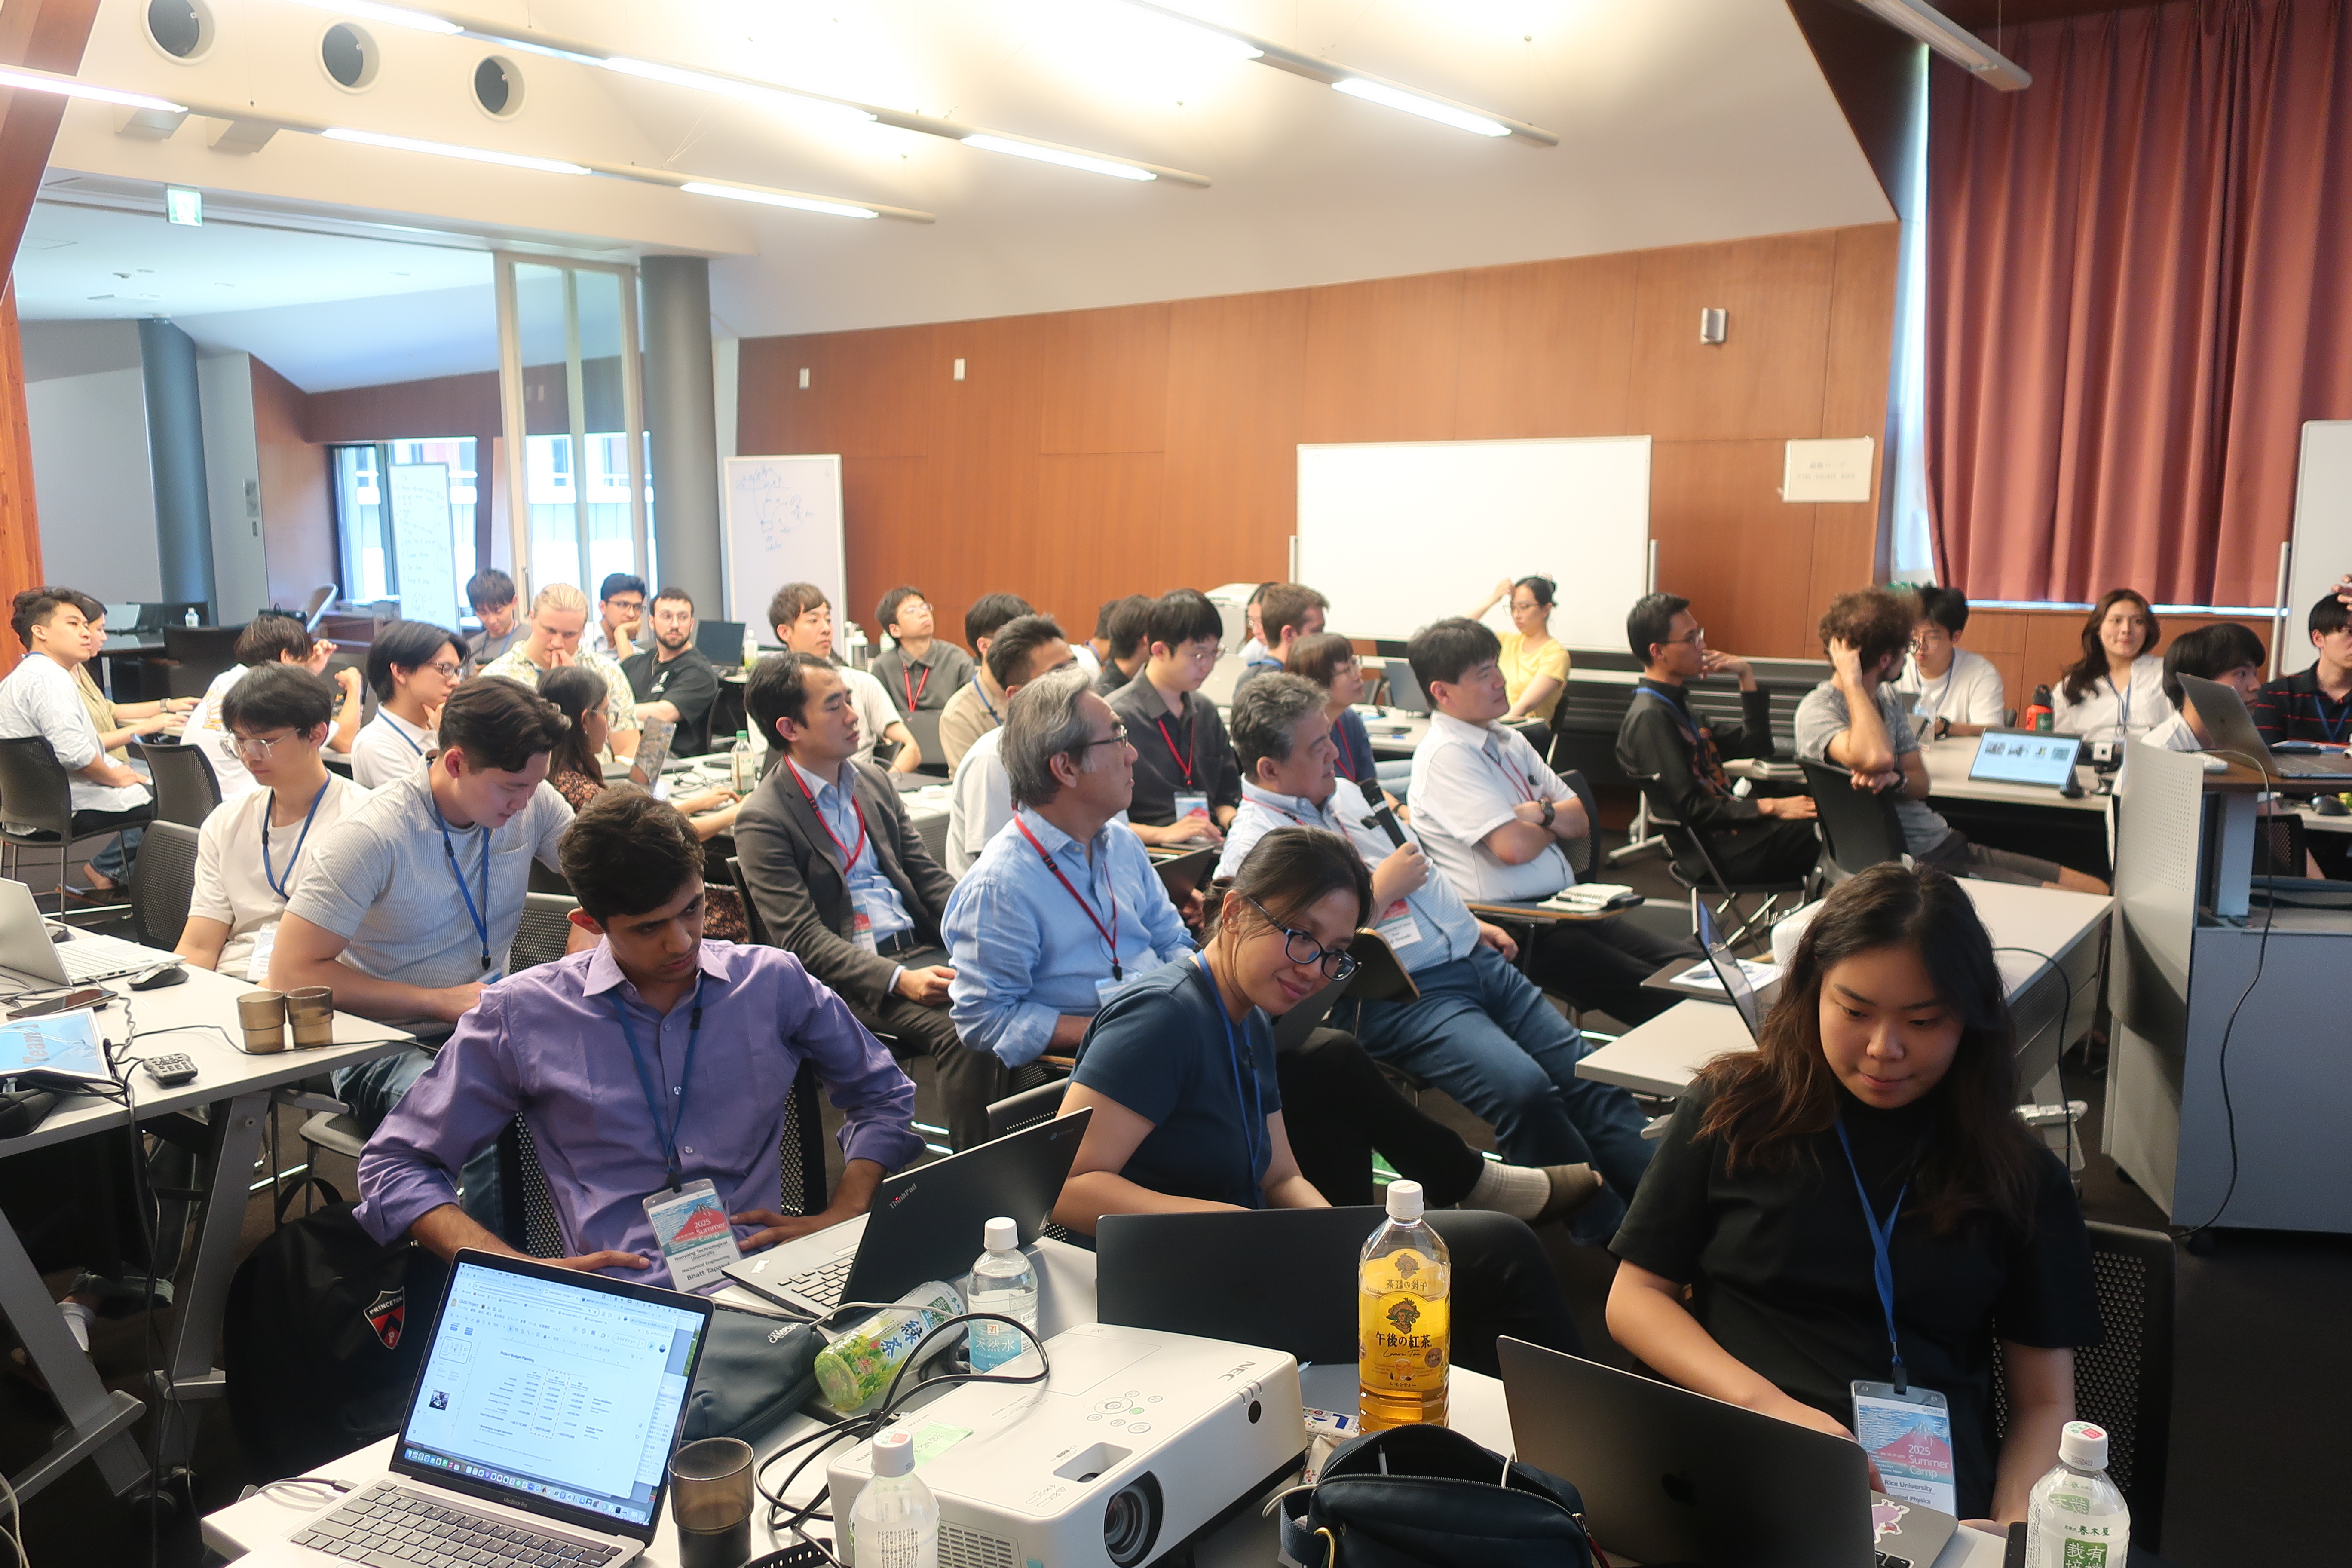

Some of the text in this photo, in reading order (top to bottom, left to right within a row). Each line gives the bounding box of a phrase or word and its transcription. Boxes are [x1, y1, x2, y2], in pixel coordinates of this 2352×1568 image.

[22, 1033, 50, 1064] Team
[889, 1183, 917, 1209] ThinkPad
[694, 1219, 711, 1229] 2025
[696, 1222, 725, 1235] Summer
[699, 1234, 720, 1242] Camp
[674, 1250, 696, 1261] Nanyang
[697, 1240, 728, 1253] Technological
[691, 1251, 715, 1261] University
[682, 1255, 730, 1273] Mechanical Engineering
[687, 1271, 704, 1280] Bhatt
[369, 1295, 403, 1315] PRINCETON
[976, 1337, 1016, 1352] 天然水
[1375, 1331, 1432, 1348] 午後の紅茶
[1383, 1349, 1406, 1357] Lemon
[1217, 1361, 1257, 1381] NEC
[1908, 1444, 1931, 1455] 2025
[1908, 1455, 1949, 1469] Summer
[1910, 1466, 1937, 1479] Camp
[1900, 1481, 1933, 1492] University
[1910, 1495, 1931, 1504] Physics
